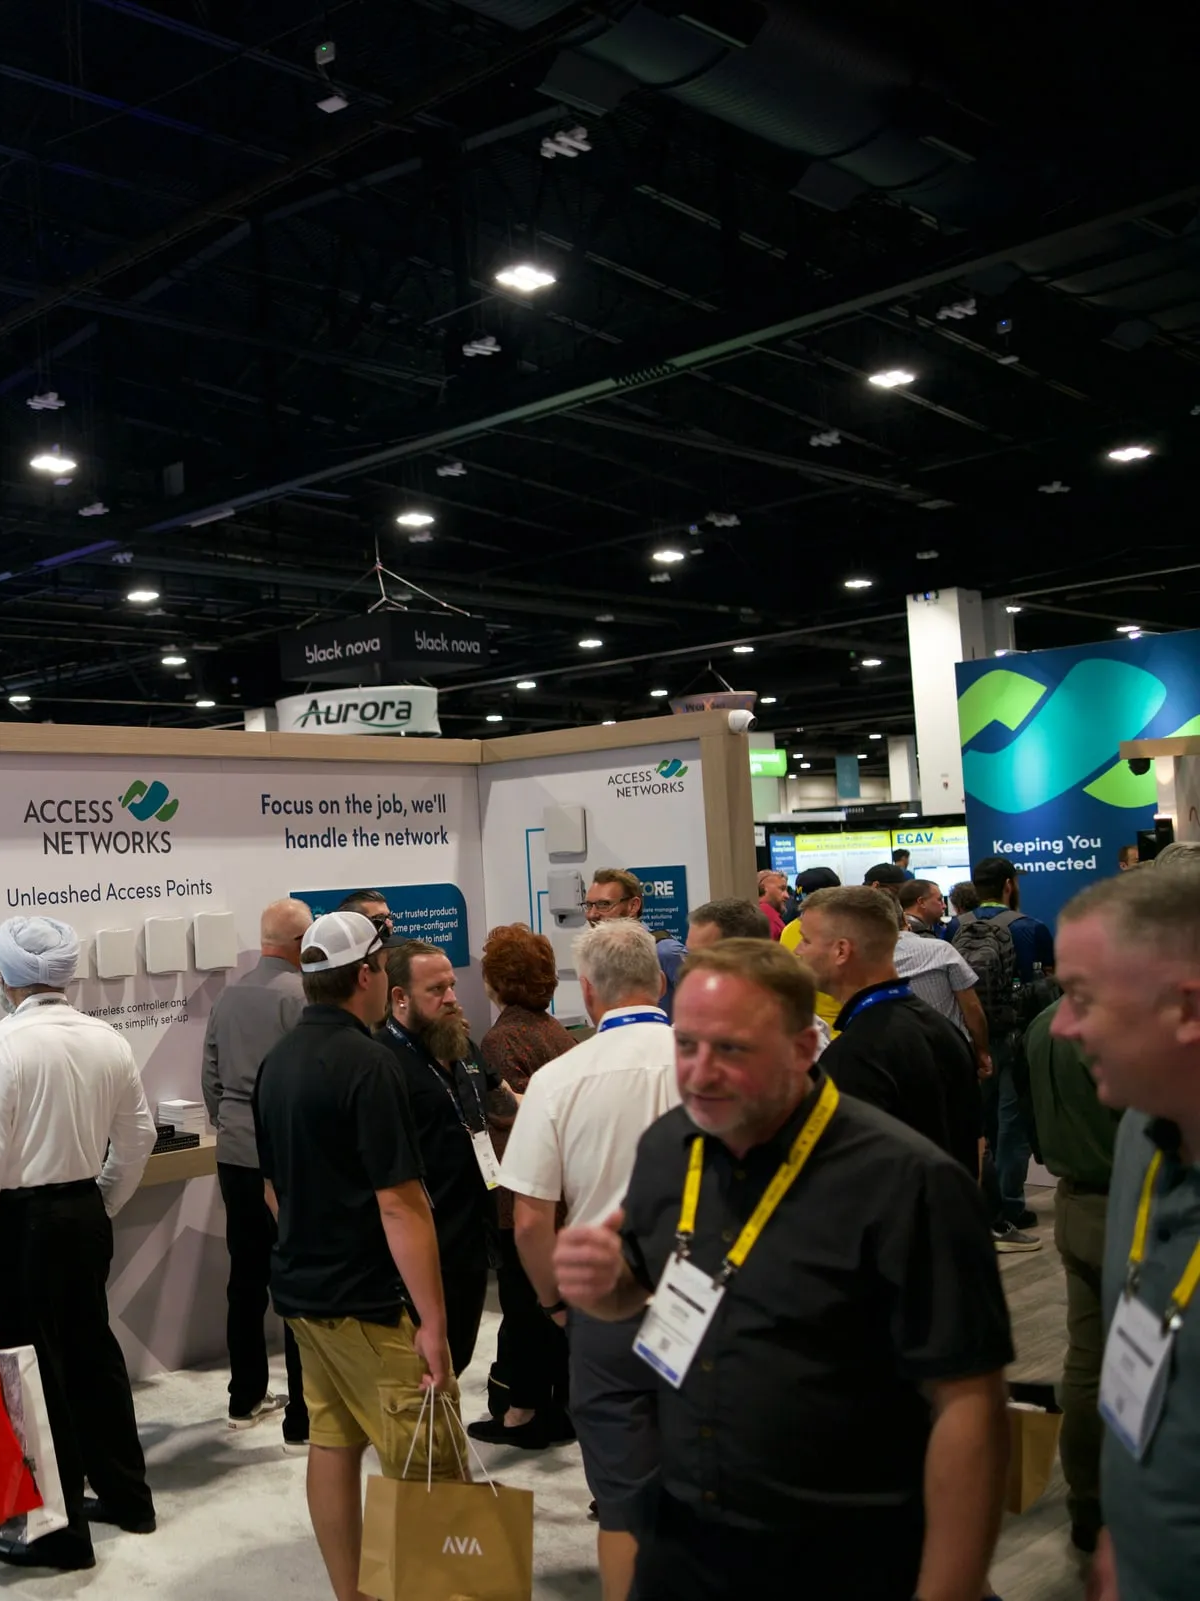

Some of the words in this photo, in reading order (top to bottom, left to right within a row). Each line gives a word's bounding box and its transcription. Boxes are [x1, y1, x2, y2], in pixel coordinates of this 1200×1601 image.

[305, 640, 342, 664] black
[346, 638, 380, 656] nova
[414, 630, 448, 652] black
[451, 639, 480, 653] nova
[299, 699, 412, 728] Aurora
[607, 771, 652, 786] ACCESS
[616, 781, 684, 798] NETWORKS
[23, 799, 114, 824] ACCESS
[261, 793, 314, 815] Focus
[319, 799, 340, 815] on
[345, 793, 373, 814] the
[376, 793, 407, 820] job,
[411, 793, 447, 813] we'll
[43, 830, 172, 855] NETWORKS
[285, 827, 348, 849] handle
[352, 826, 380, 847] the
[385, 825, 449, 847] network
[897, 832, 933, 844] ECAV
[993, 837, 1063, 856] Keeping
[1067, 835, 1102, 849] You
[1014, 855, 1097, 872] onnected
[7, 883, 101, 907] Unleashed
[106, 883, 161, 901] Access
[166, 879, 213, 897] Points
[640, 881, 674, 897] ORE
[405, 907, 428, 918] trusted
[429, 906, 458, 919] products
[392, 925, 408, 933] ome
[409, 918, 459, 934] pre-configured
[425, 935, 432, 943] to
[434, 932, 453, 943] install
[88, 1004, 125, 1018] wireless
[127, 999, 168, 1013] controller
[171, 996, 187, 1008] and
[125, 1015, 158, 1030] simplify
[161, 1013, 189, 1026] set-up
[442, 1536, 483, 1556] AVA
